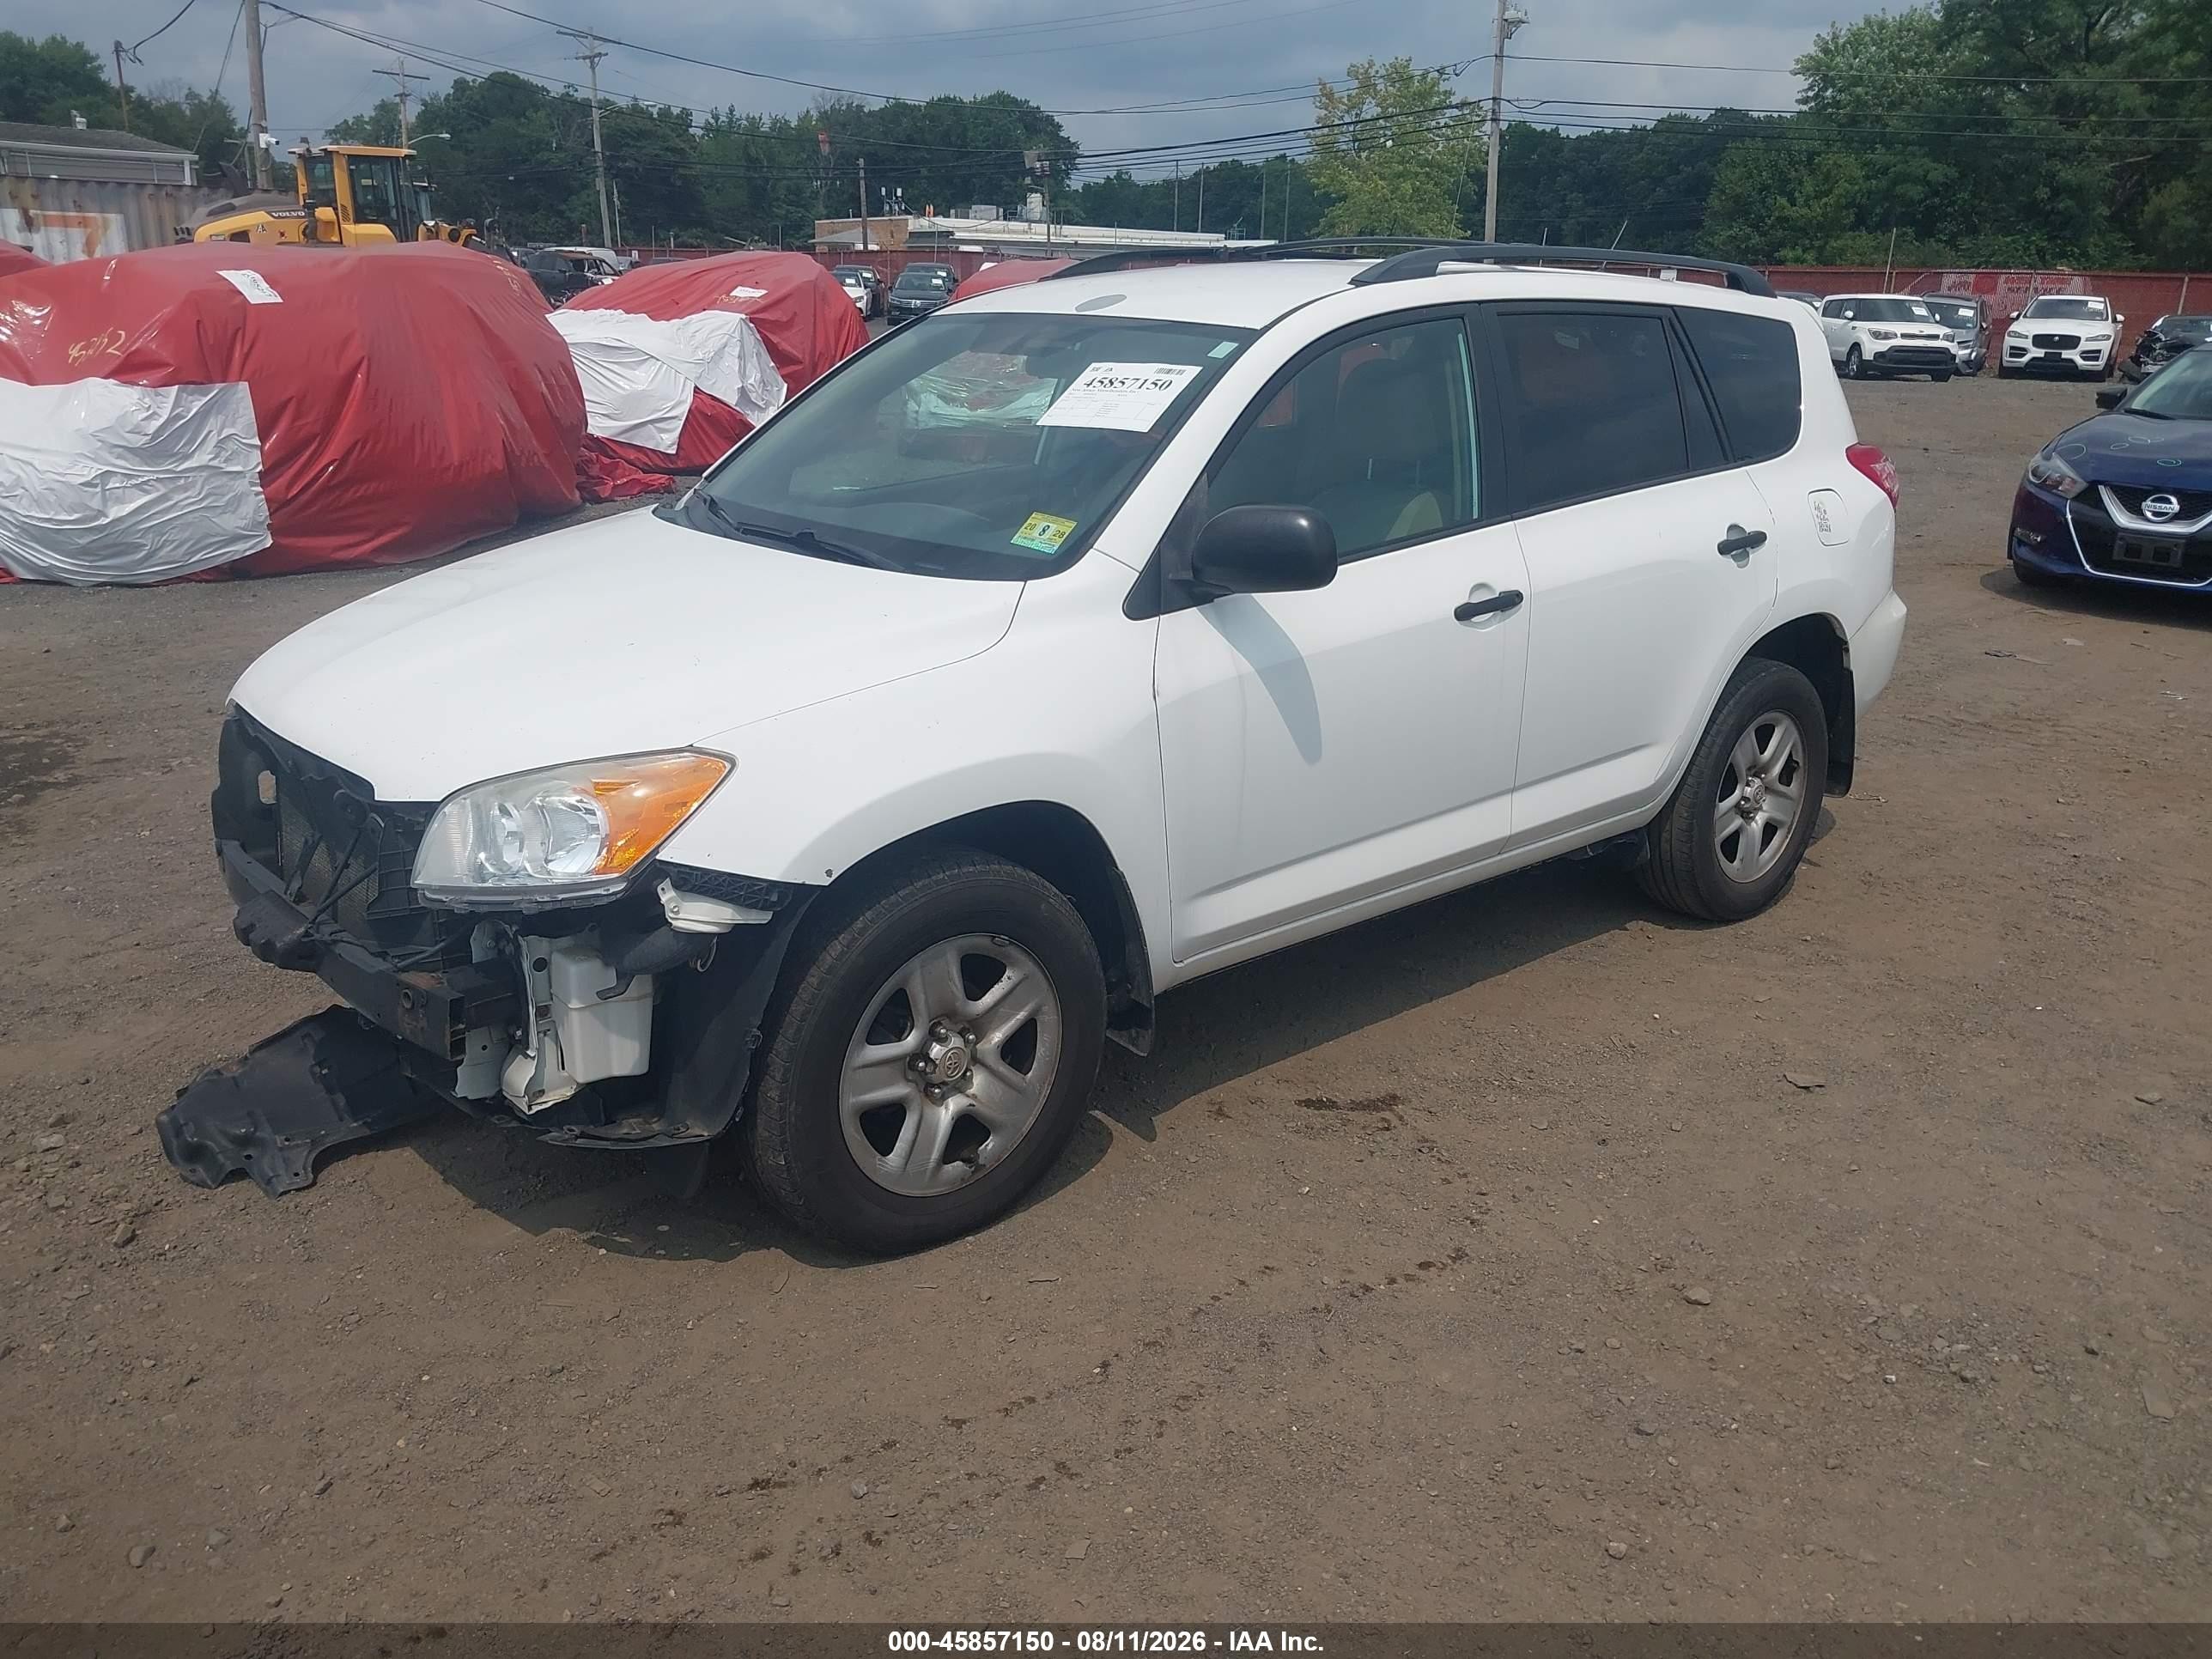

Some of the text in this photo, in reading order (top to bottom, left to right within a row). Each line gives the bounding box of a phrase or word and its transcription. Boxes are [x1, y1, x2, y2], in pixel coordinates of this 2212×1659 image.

[1084, 376, 1174, 392] 45857150
[2144, 503, 2175, 512] NISSAN
[1024, 522, 1066, 538] 20 8 28
